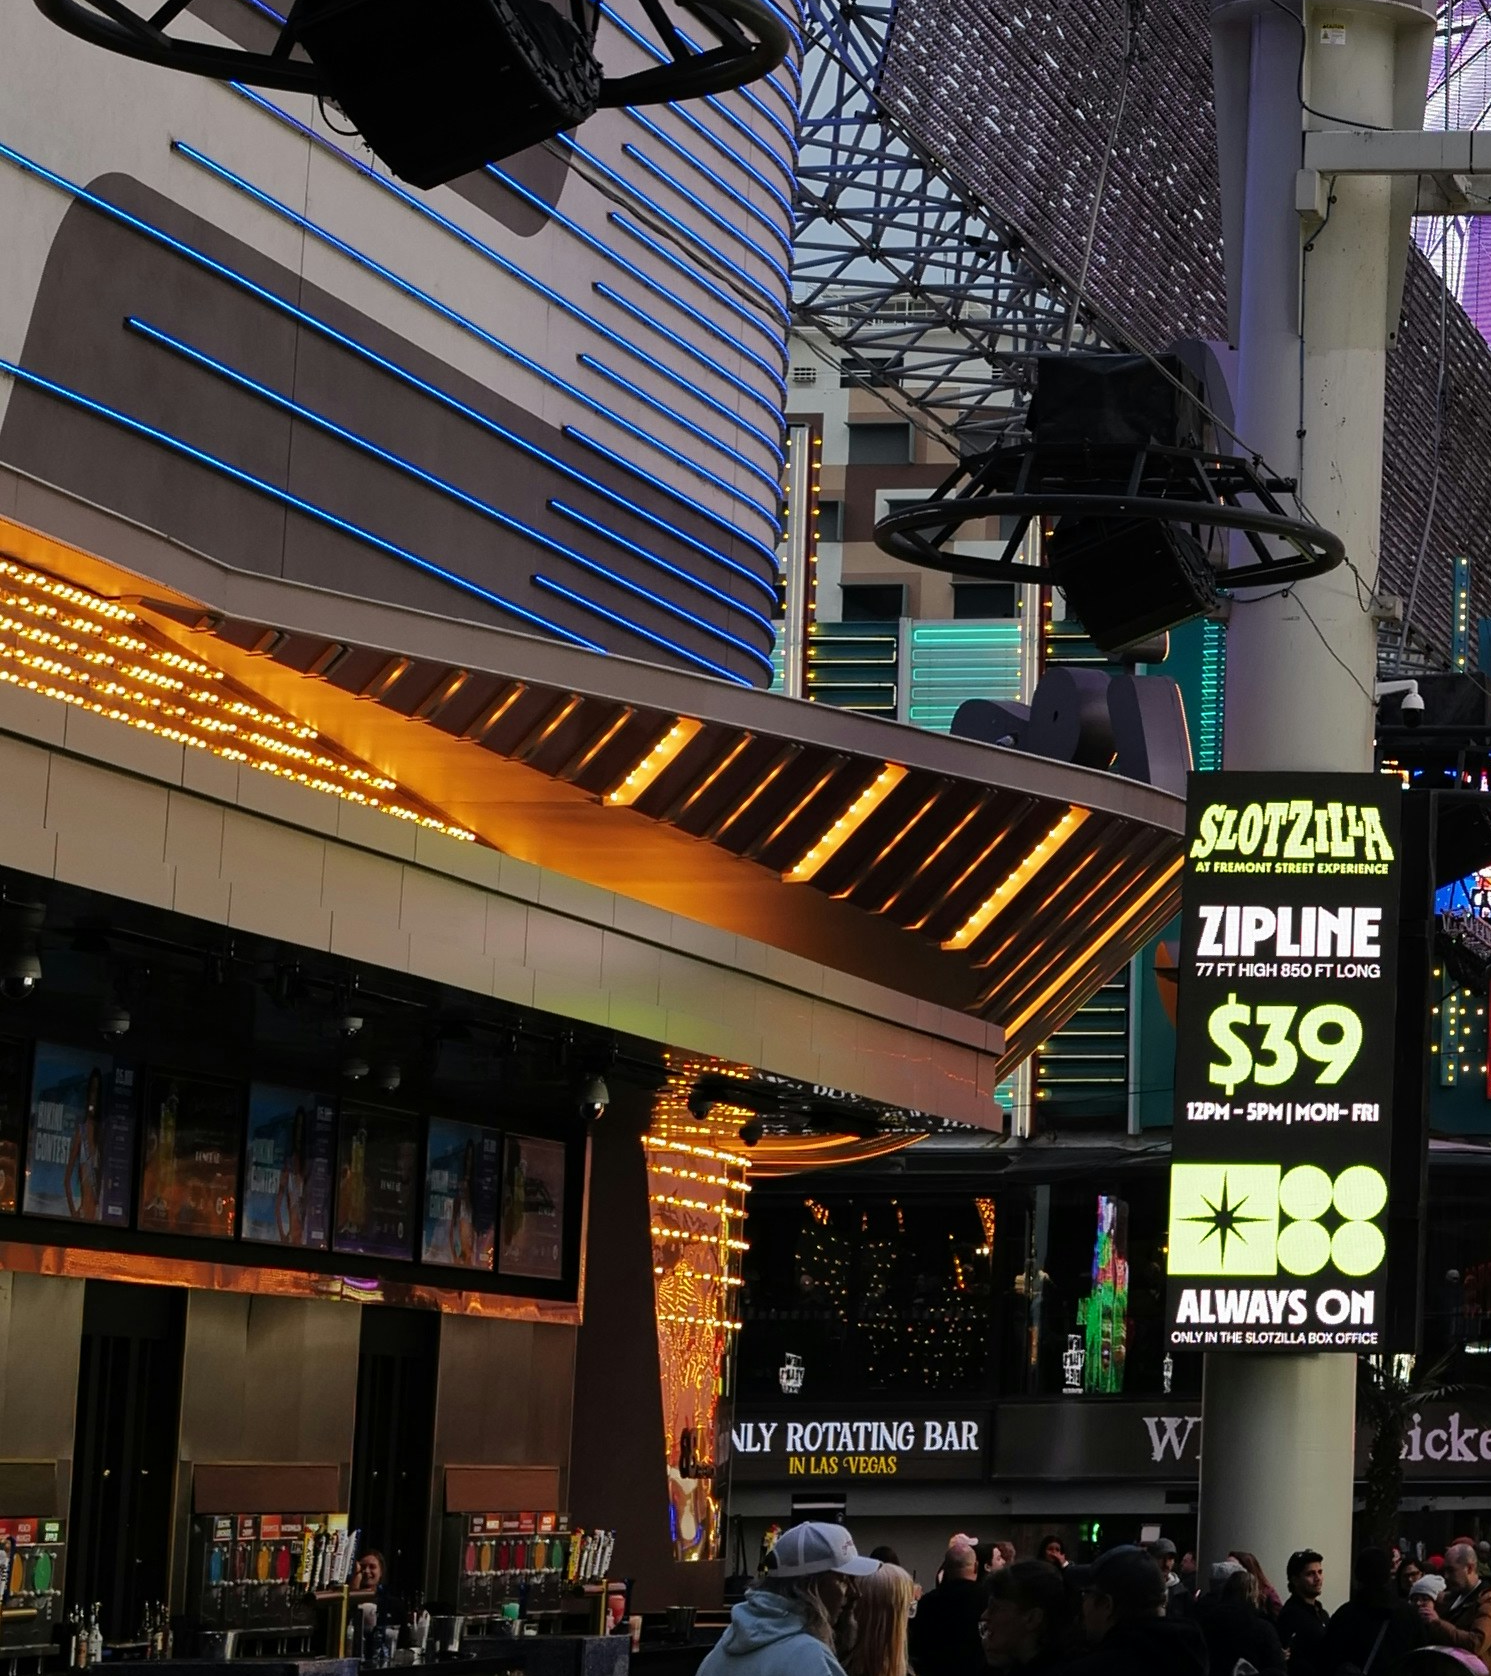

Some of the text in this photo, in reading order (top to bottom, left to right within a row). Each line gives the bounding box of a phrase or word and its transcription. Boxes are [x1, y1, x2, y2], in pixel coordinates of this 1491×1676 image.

[1190, 800, 1394, 861] SLOTZILLA
[1195, 862, 1389, 874] AT FREMONT STREET EXPERIENCE
[1197, 906, 1382, 957] ZIPLINE
[1196, 963, 1381, 978] 77 FT HIGH 850 FT LONG
[1208, 993, 1363, 1096] $39
[1187, 1102, 1230, 1120] 12PM
[1246, 1102, 1283, 1121] 5PM
[1352, 1103, 1379, 1122] FRI
[1175, 1289, 1375, 1324] ALWAYS ON
[1171, 1331, 1378, 1344] ONLY IN THE SLOTZILLA BOX OFFICE
[786, 1421, 915, 1452] ROTATING
[923, 1421, 979, 1452] BAR
[789, 1456, 897, 1475] IN LAS VEGAS
